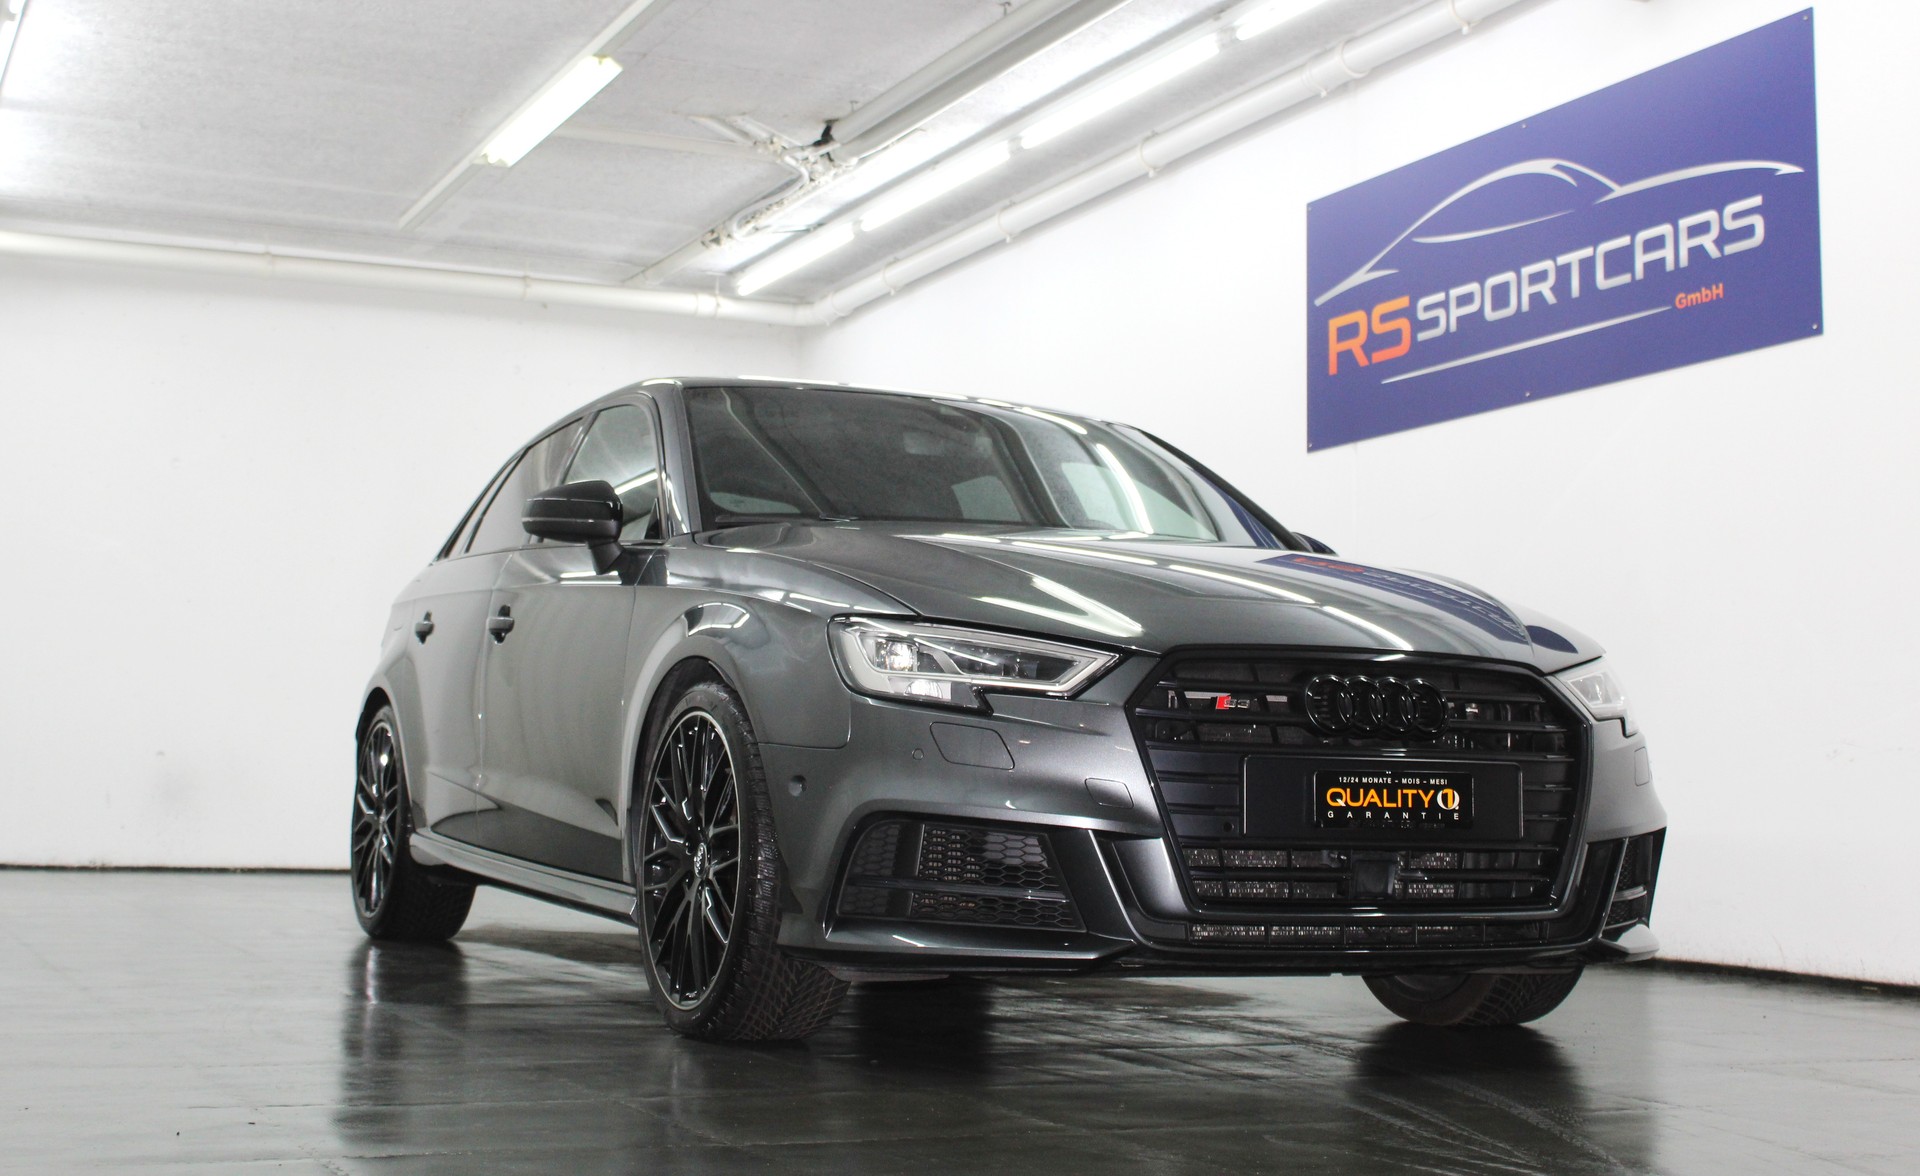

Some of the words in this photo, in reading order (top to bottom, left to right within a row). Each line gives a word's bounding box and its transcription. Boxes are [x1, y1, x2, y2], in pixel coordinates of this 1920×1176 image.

[1328, 296, 1411, 376] RS
[1416, 194, 1765, 342] SPORTCARS
[1675, 283, 1724, 310] GmbH
[1326, 787, 1434, 808] QUALITY
[1327, 811, 1459, 820] GARANTIE
